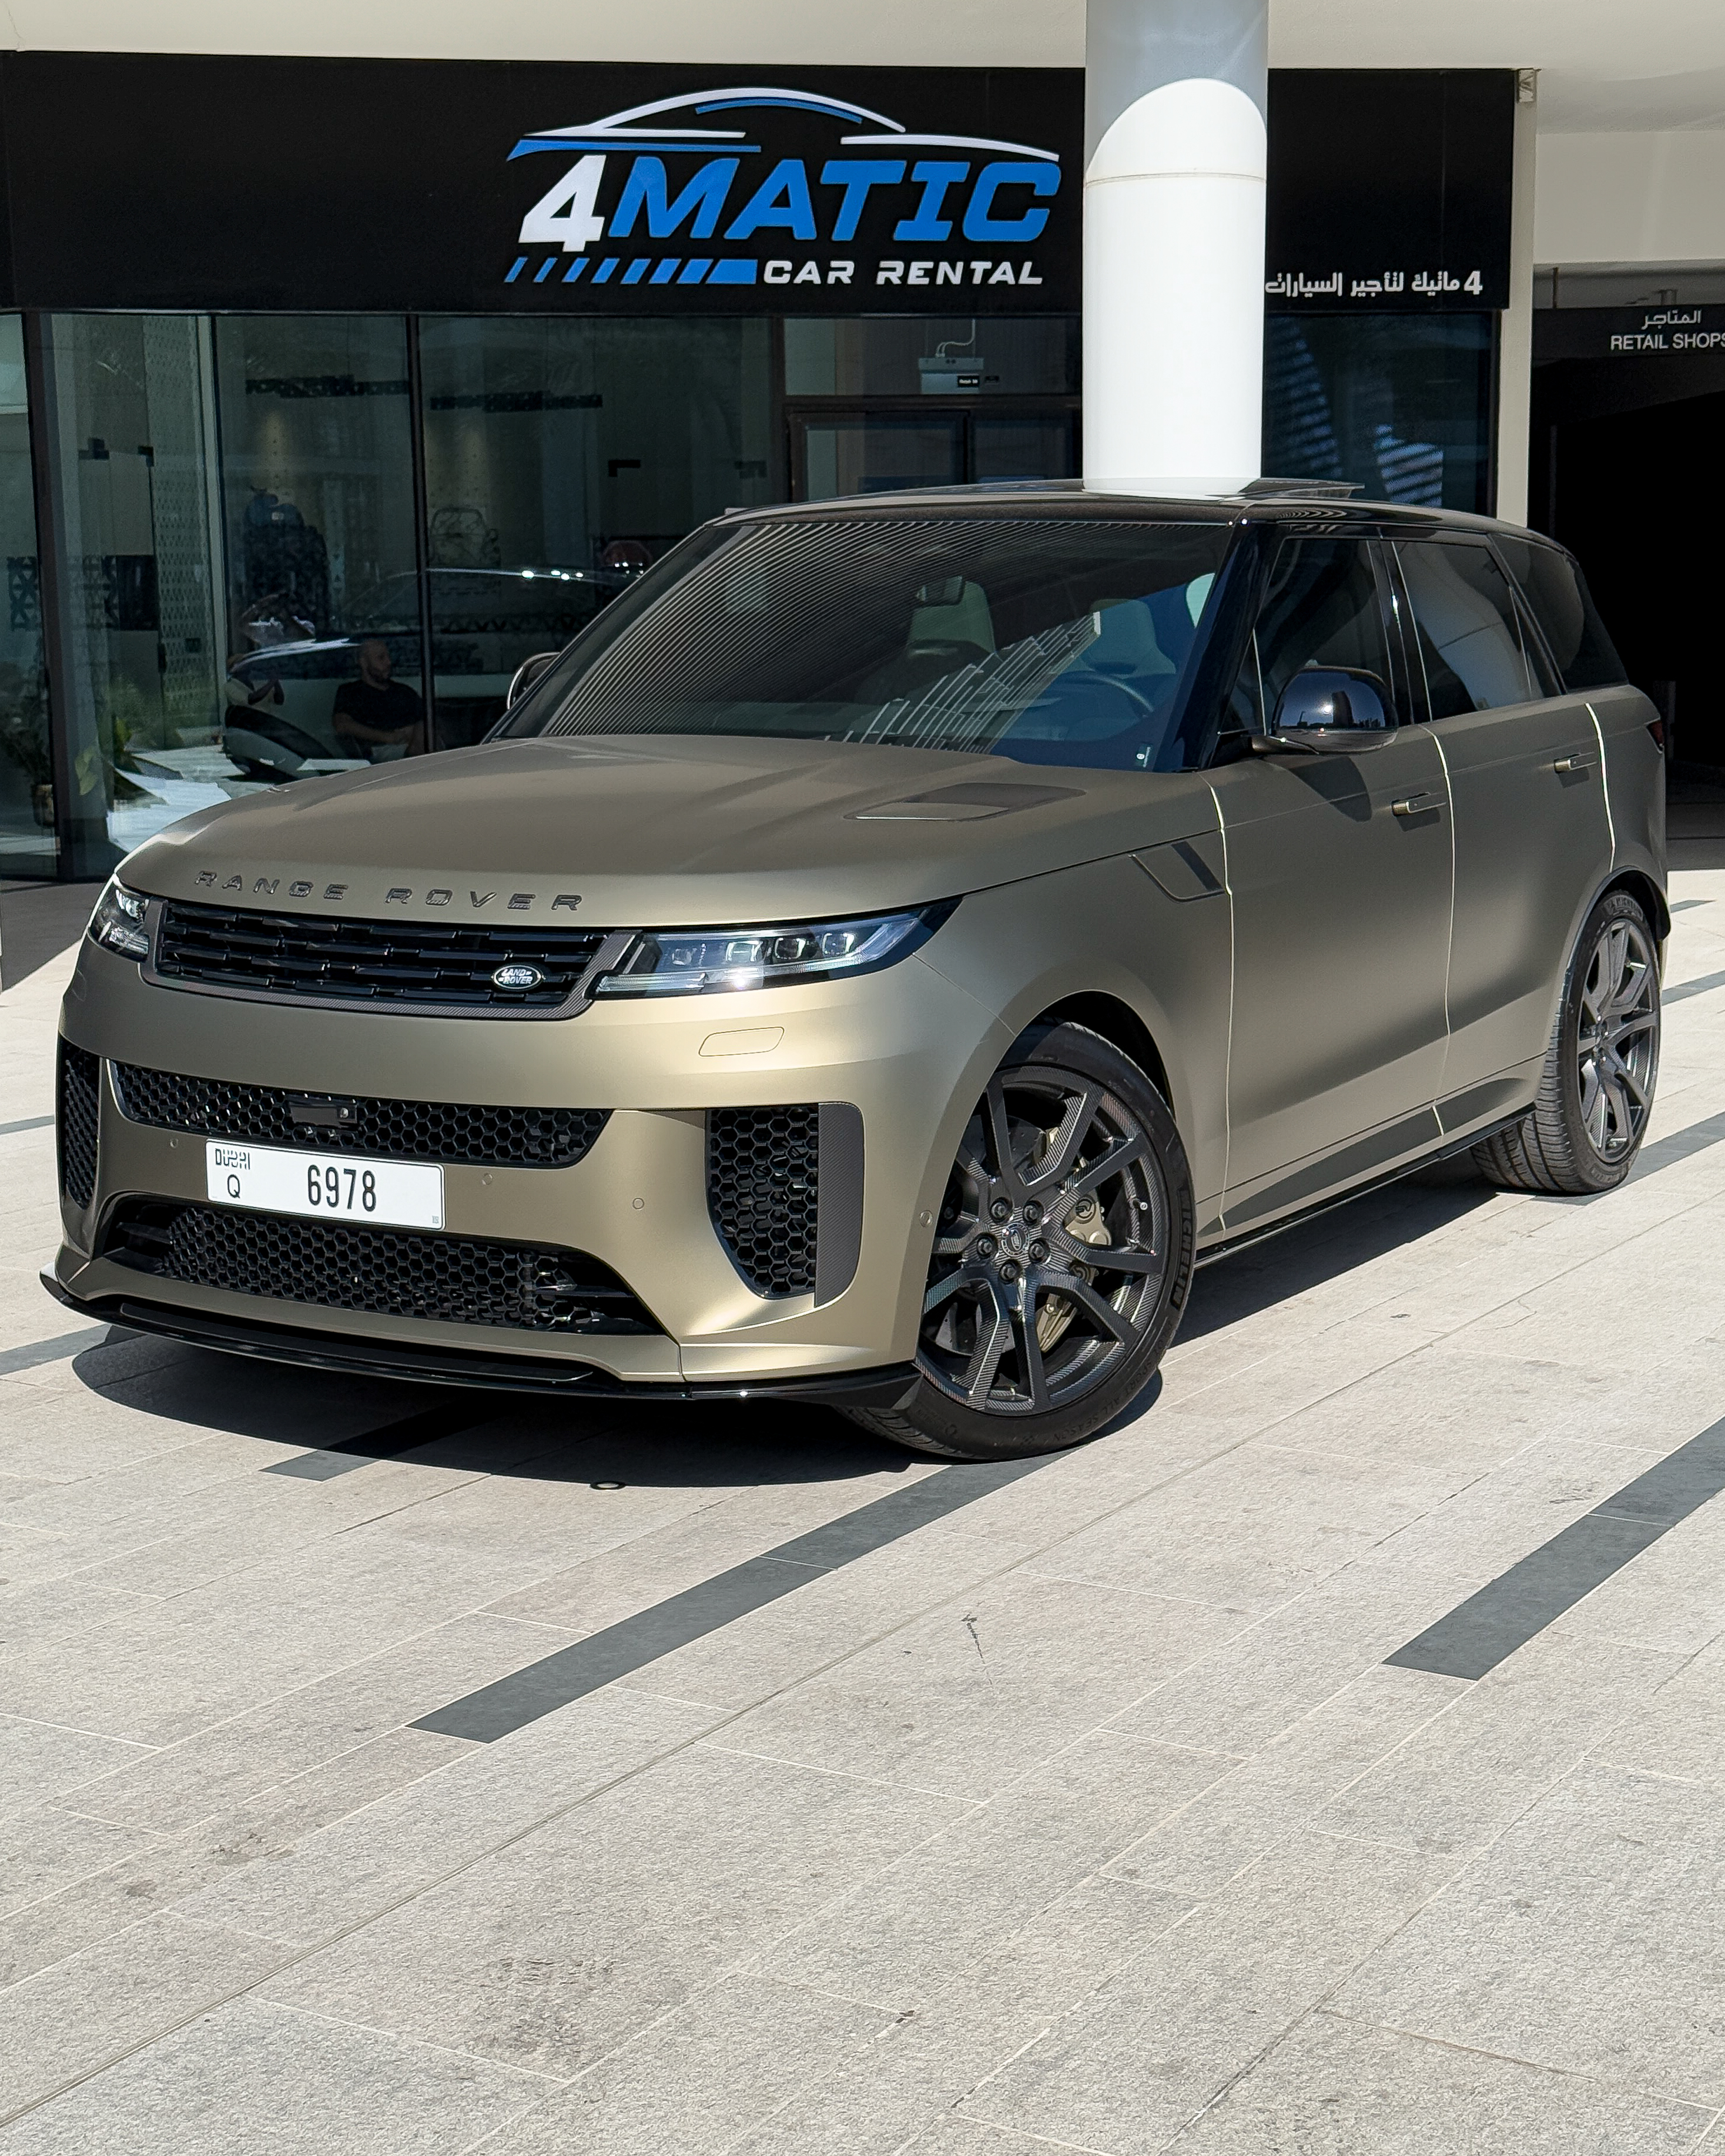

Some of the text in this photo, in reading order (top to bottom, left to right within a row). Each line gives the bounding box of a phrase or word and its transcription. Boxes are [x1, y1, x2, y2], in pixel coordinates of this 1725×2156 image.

[518, 155, 1061, 252] 4MATIC
[763, 260, 1043, 286] CAR RENTAL
[1411, 270, 1461, 297] ماتيك
[1463, 270, 1483, 295] 4
[1641, 309, 1702, 330] المتاجر
[1610, 334, 1669, 351] RETAIL
[195, 870, 582, 911] RANGE ROVER
[227, 1174, 240, 1199] Q
[307, 1165, 377, 1212] 6978
[1173, 1189, 1193, 1305] MICHELIN
